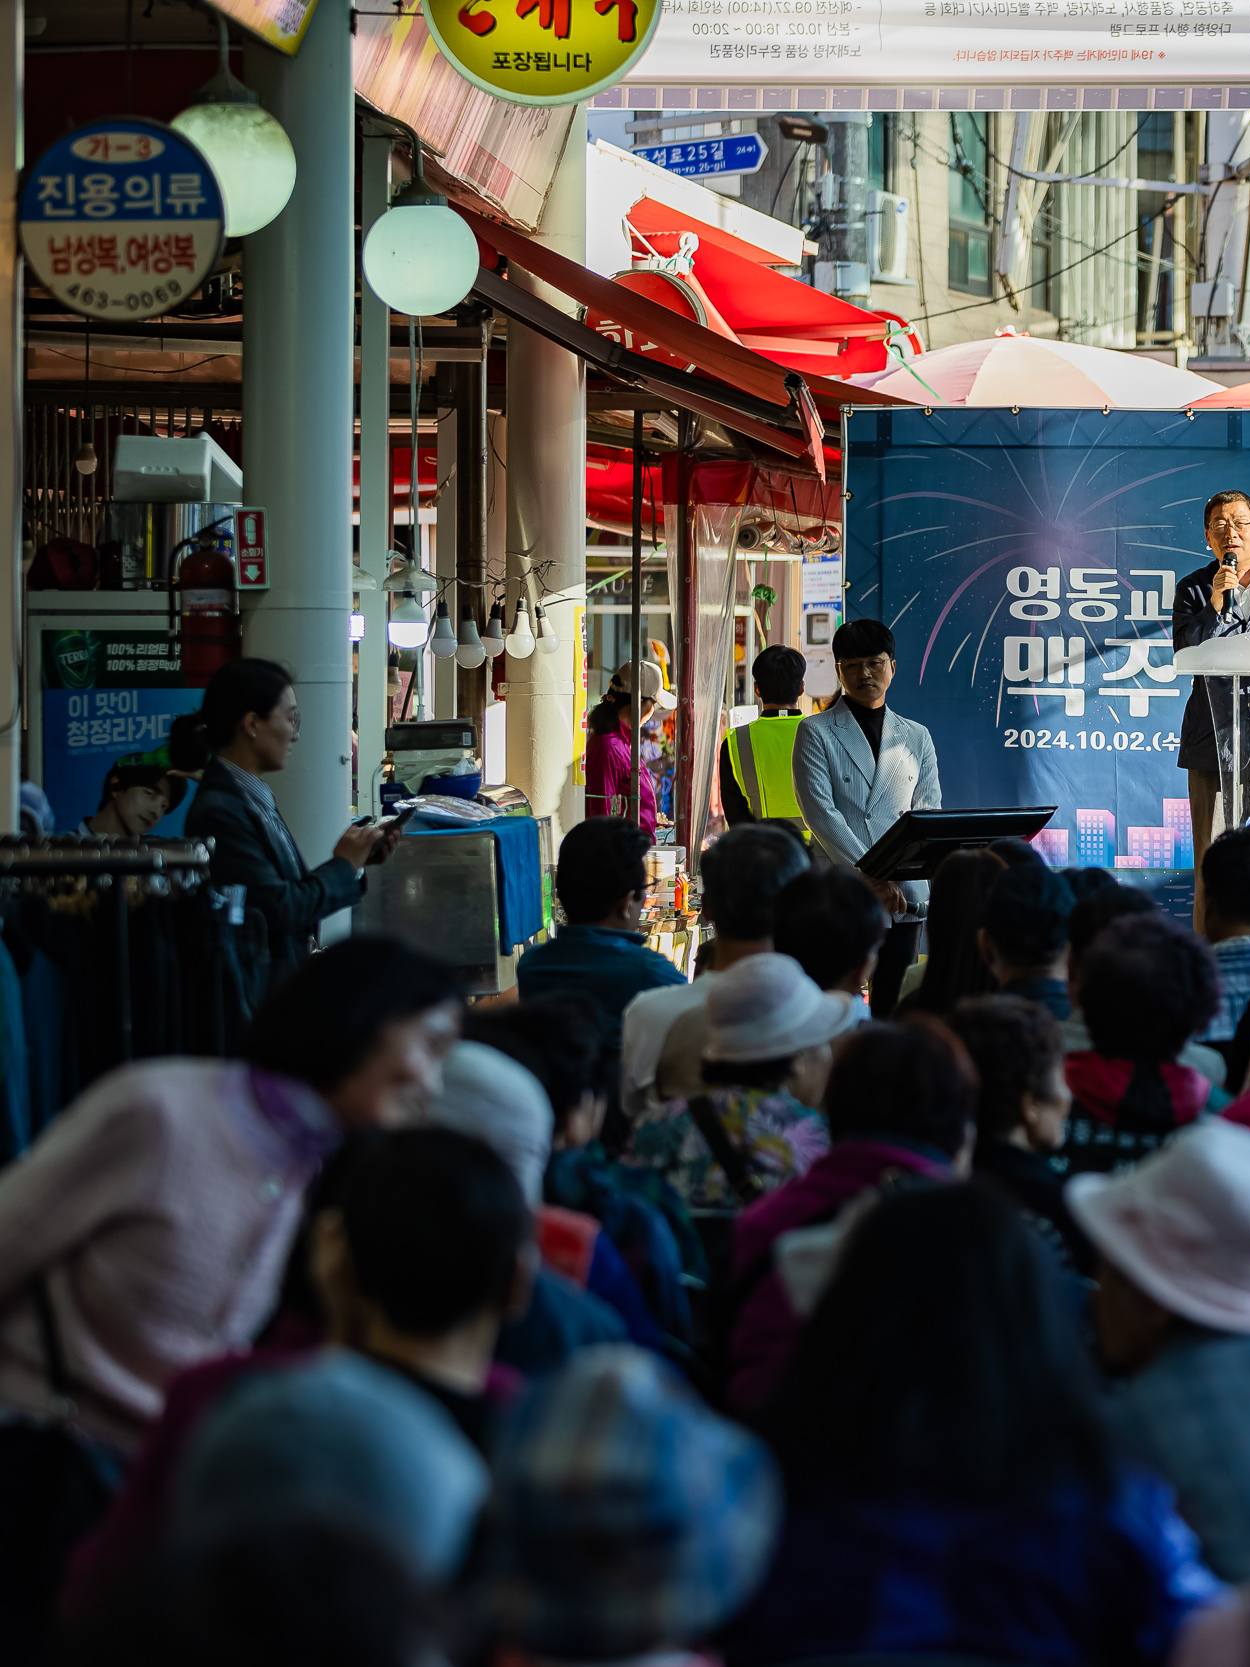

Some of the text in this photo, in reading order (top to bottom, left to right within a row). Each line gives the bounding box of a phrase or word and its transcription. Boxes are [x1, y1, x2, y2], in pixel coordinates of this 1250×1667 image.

[491, 51, 593, 73] 포장됩니다
[698, 160, 726, 173] 25-gil
[37, 172, 207, 218] 진용의류
[65, 278, 183, 312] 463-0069
[1006, 566, 1176, 622] 영동교
[59, 649, 90, 666] TERRA
[106, 643, 135, 656] 100%
[106, 659, 135, 672] 100%
[68, 690, 139, 718] 이 맛이
